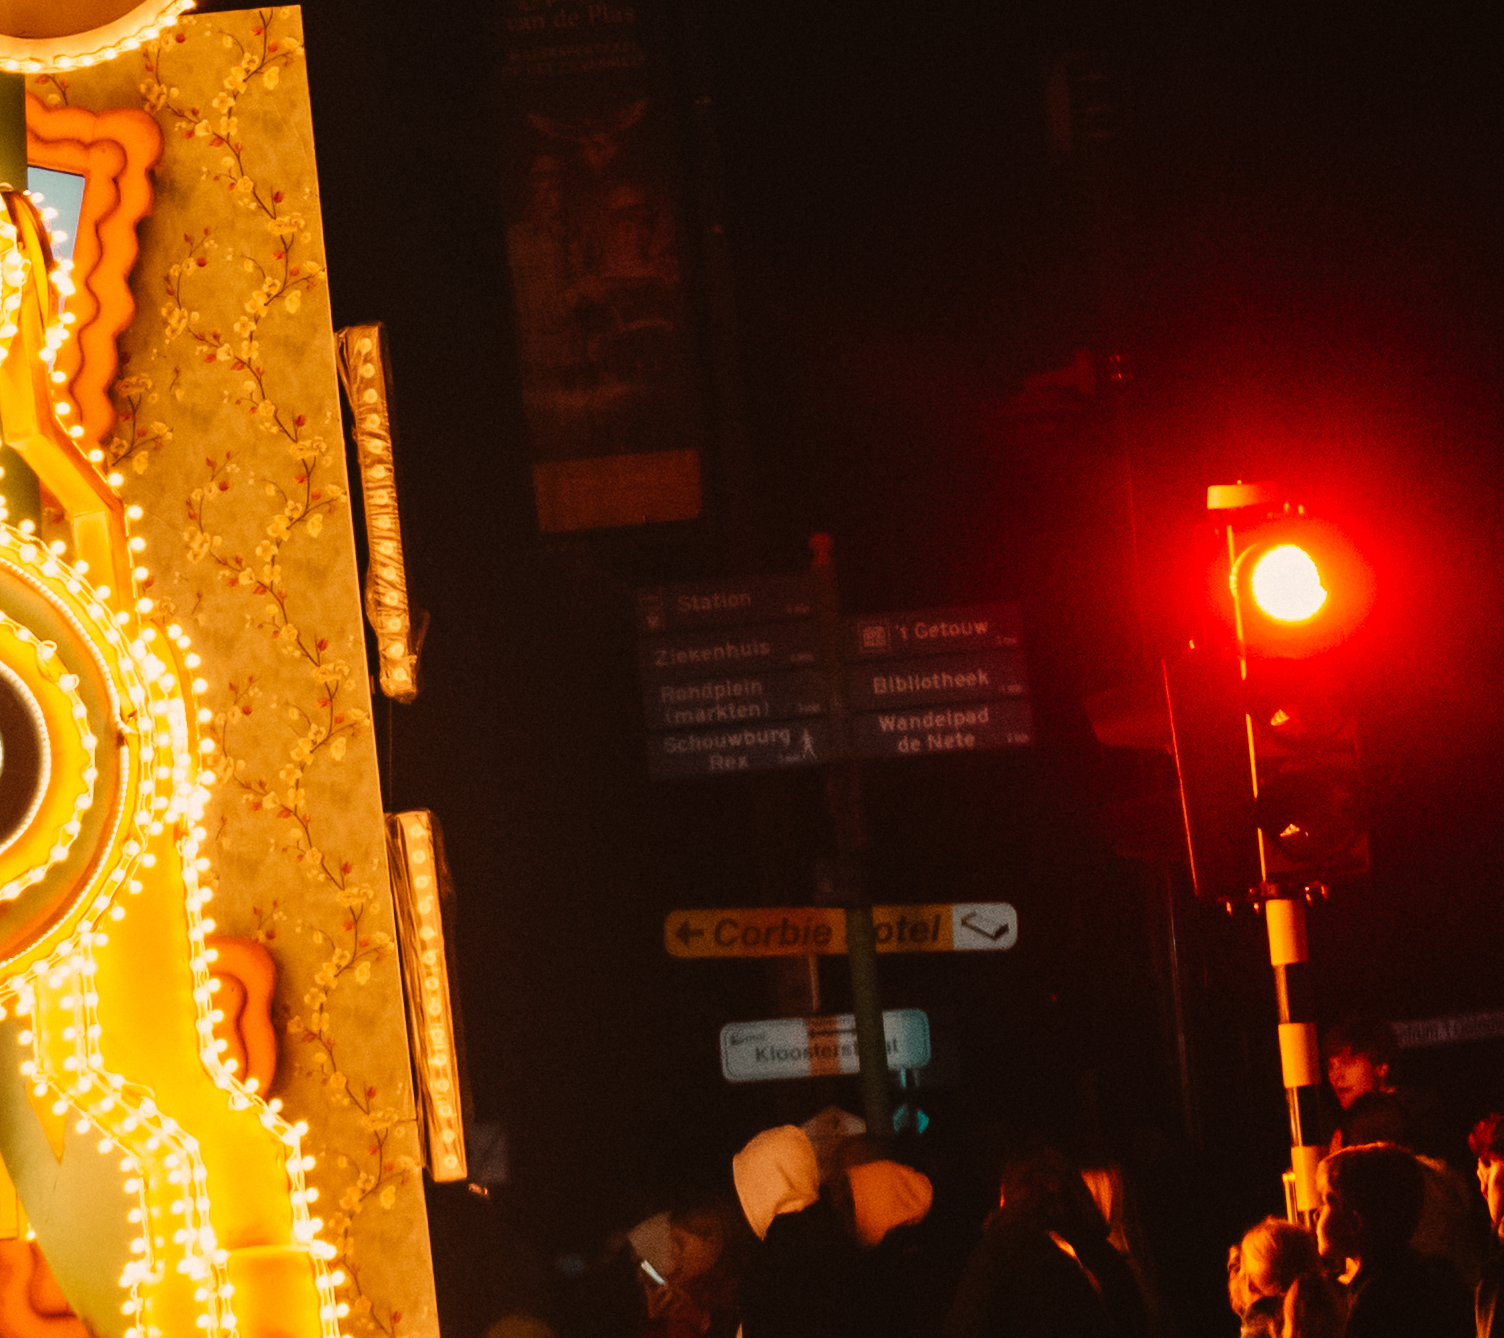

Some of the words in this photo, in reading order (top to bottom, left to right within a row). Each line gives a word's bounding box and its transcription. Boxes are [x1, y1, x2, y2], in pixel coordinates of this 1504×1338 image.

[505, 13, 546, 32] van
[553, 8, 580, 28] de
[676, 591, 753, 614] Station
[914, 620, 989, 639] Getouw
[654, 639, 770, 666] Ziekenhuis
[660, 679, 763, 703] Rondplein
[871, 669, 990, 696] Bibliotheek
[665, 701, 770, 726] (markten)
[878, 707, 990, 732] Wandelpad
[663, 728, 790, 754] Schouwburg
[897, 735, 921, 754] de
[926, 731, 976, 751] Nete
[709, 755, 749, 773] Rex
[713, 917, 832, 948] Corbie
[874, 913, 942, 944] otel
